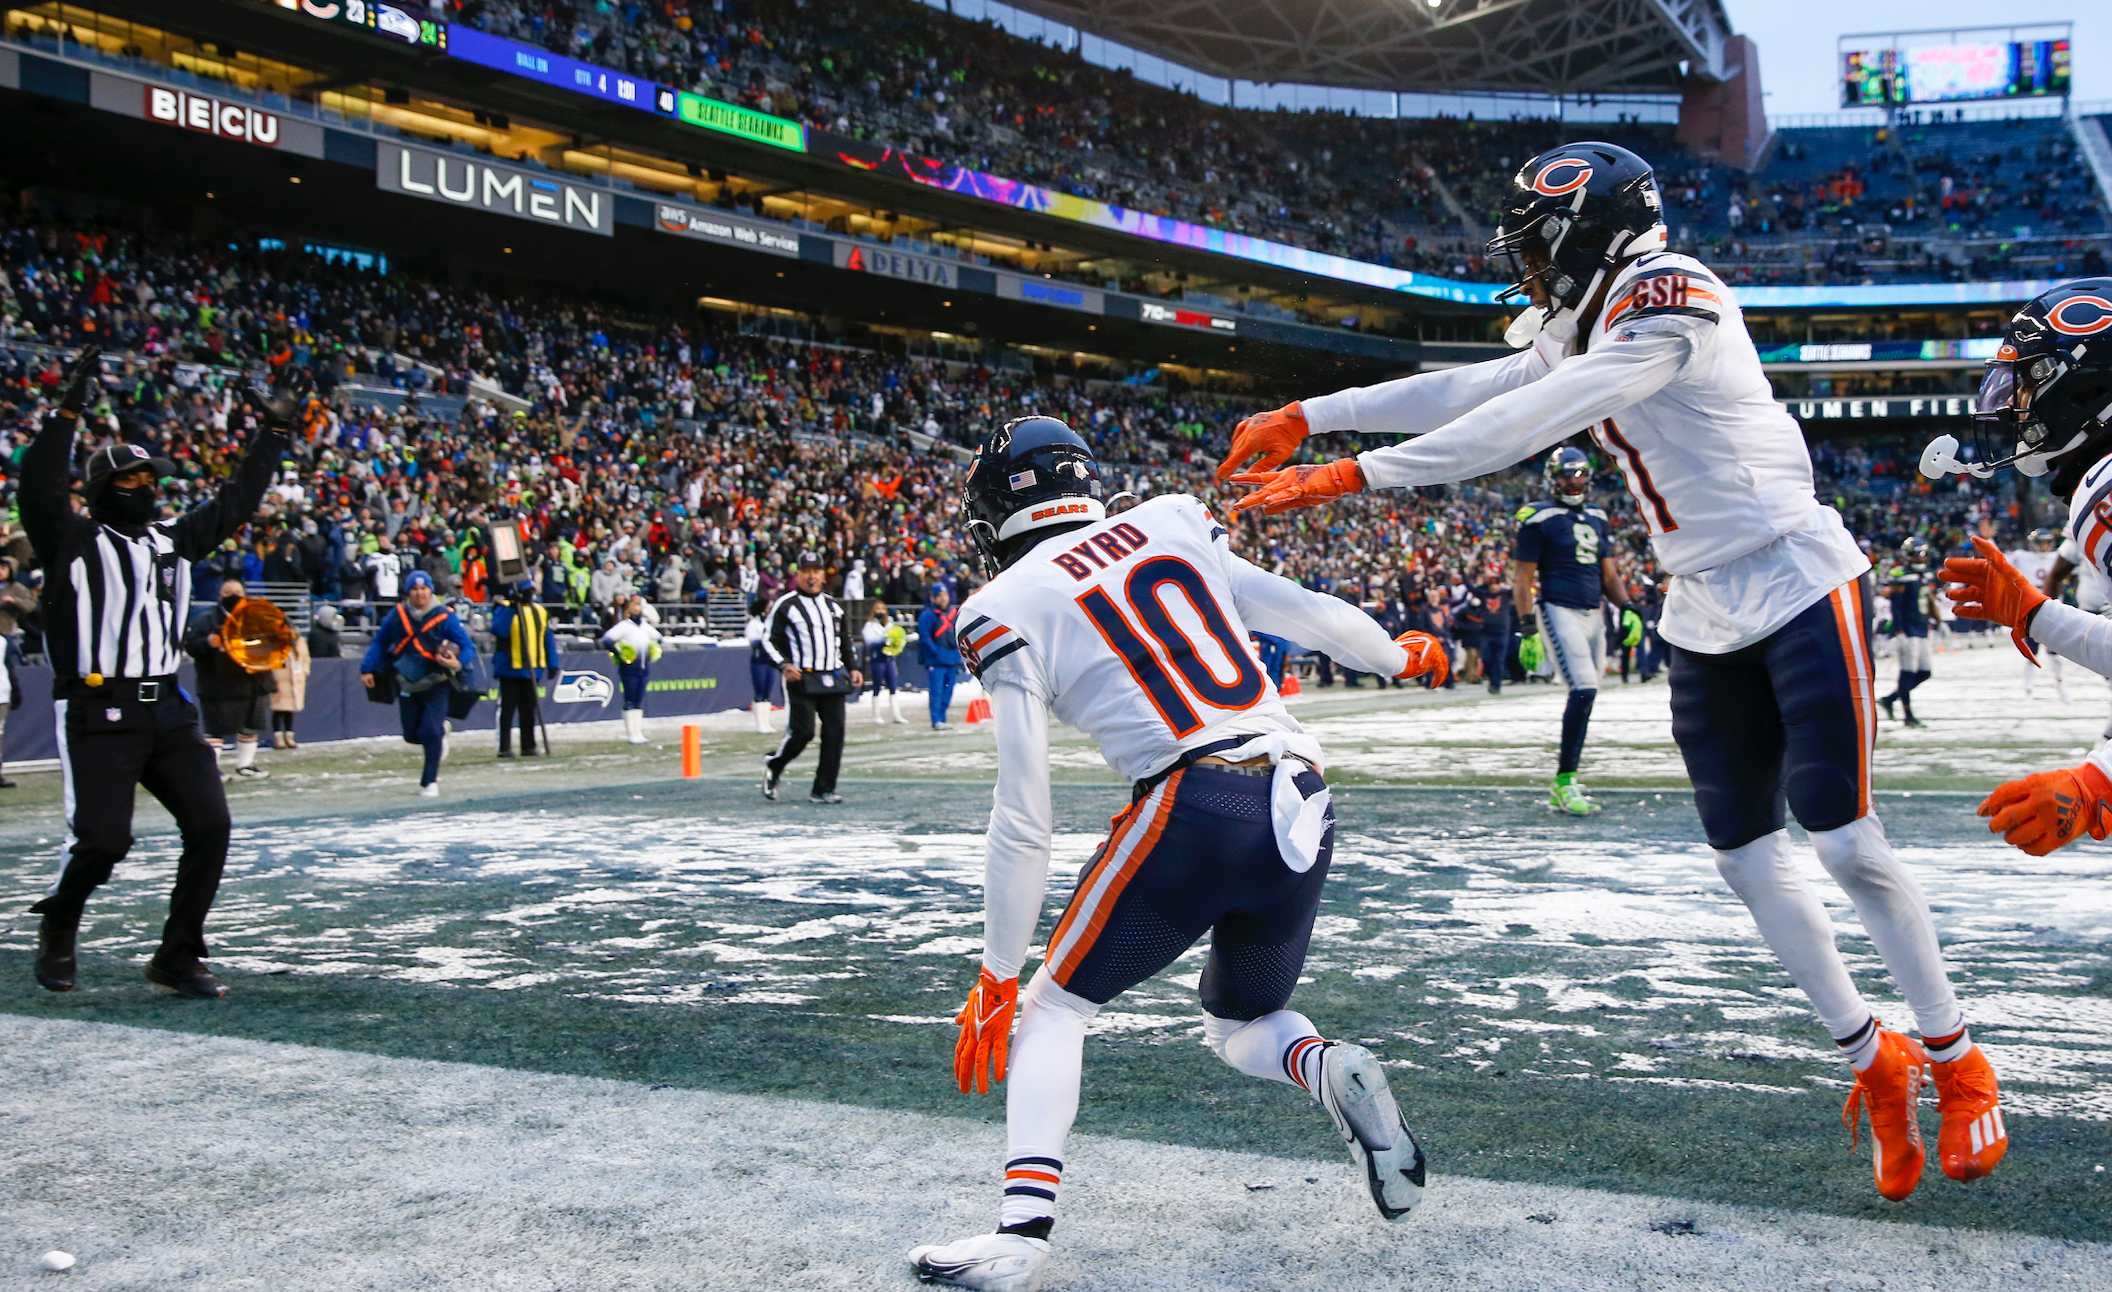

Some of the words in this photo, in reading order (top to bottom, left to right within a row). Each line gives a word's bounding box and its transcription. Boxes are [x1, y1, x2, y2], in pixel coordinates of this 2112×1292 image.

[598, 74, 607, 93] 4
[659, 91, 674, 113] 40
[698, 103, 734, 128] SEATTLE
[738, 113, 784, 140] SEAHAWKS
[401, 149, 599, 229] LUMEN
[660, 205, 687, 224] aws
[688, 216, 733, 239] Amazon
[733, 225, 758, 244] Web
[759, 231, 800, 252] Services
[872, 250, 949, 284] DELTA
[1631, 274, 1689, 311] GSH
[1910, 398, 1978, 416] FIEL
[1031, 504, 1089, 521] BEARS
[1051, 522, 1149, 581] BYRD
[1074, 555, 1266, 741] 10
[2057, 796, 2085, 839] adidas
